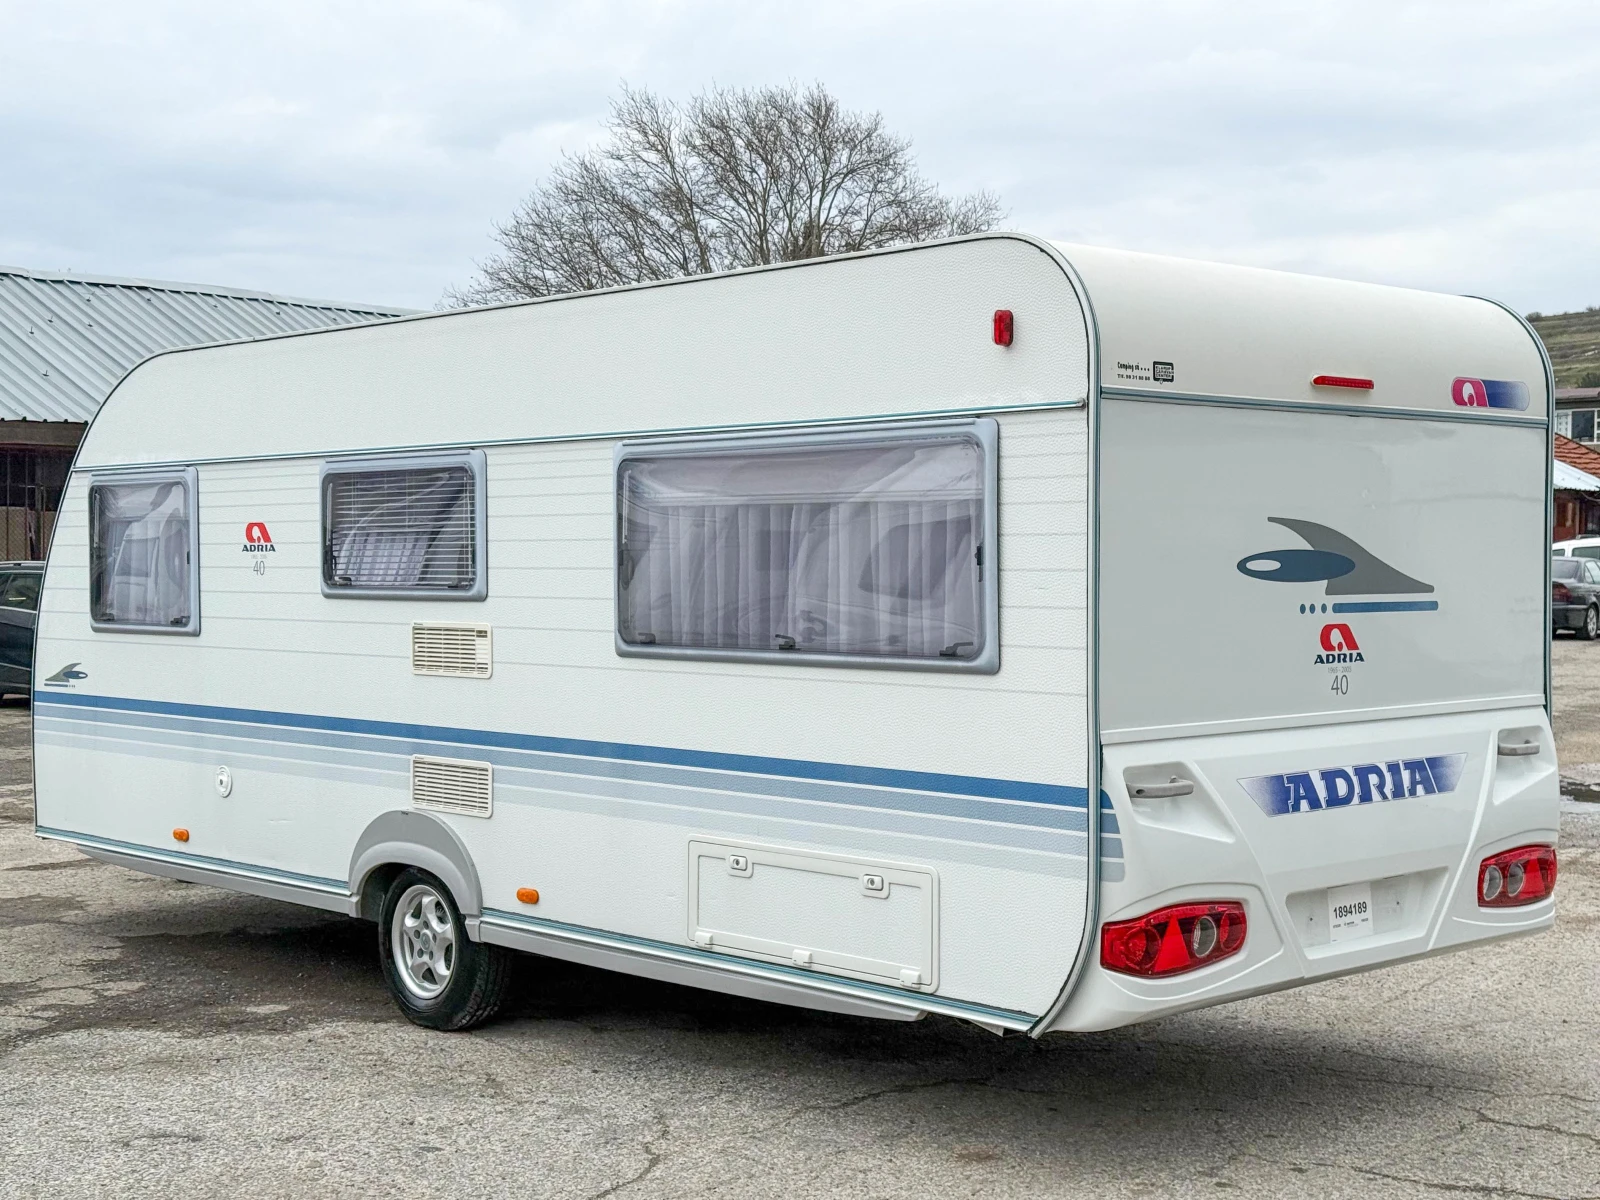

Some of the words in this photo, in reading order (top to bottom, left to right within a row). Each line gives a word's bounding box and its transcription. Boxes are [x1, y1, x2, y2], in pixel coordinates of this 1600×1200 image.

[242, 544, 276, 552] ADRIA
[253, 560, 265, 576] 40
[1314, 652, 1365, 665] ADRIA
[1331, 674, 1348, 695] 40
[1284, 758, 1438, 814] ADRIA
[1333, 901, 1367, 919] 1894189
